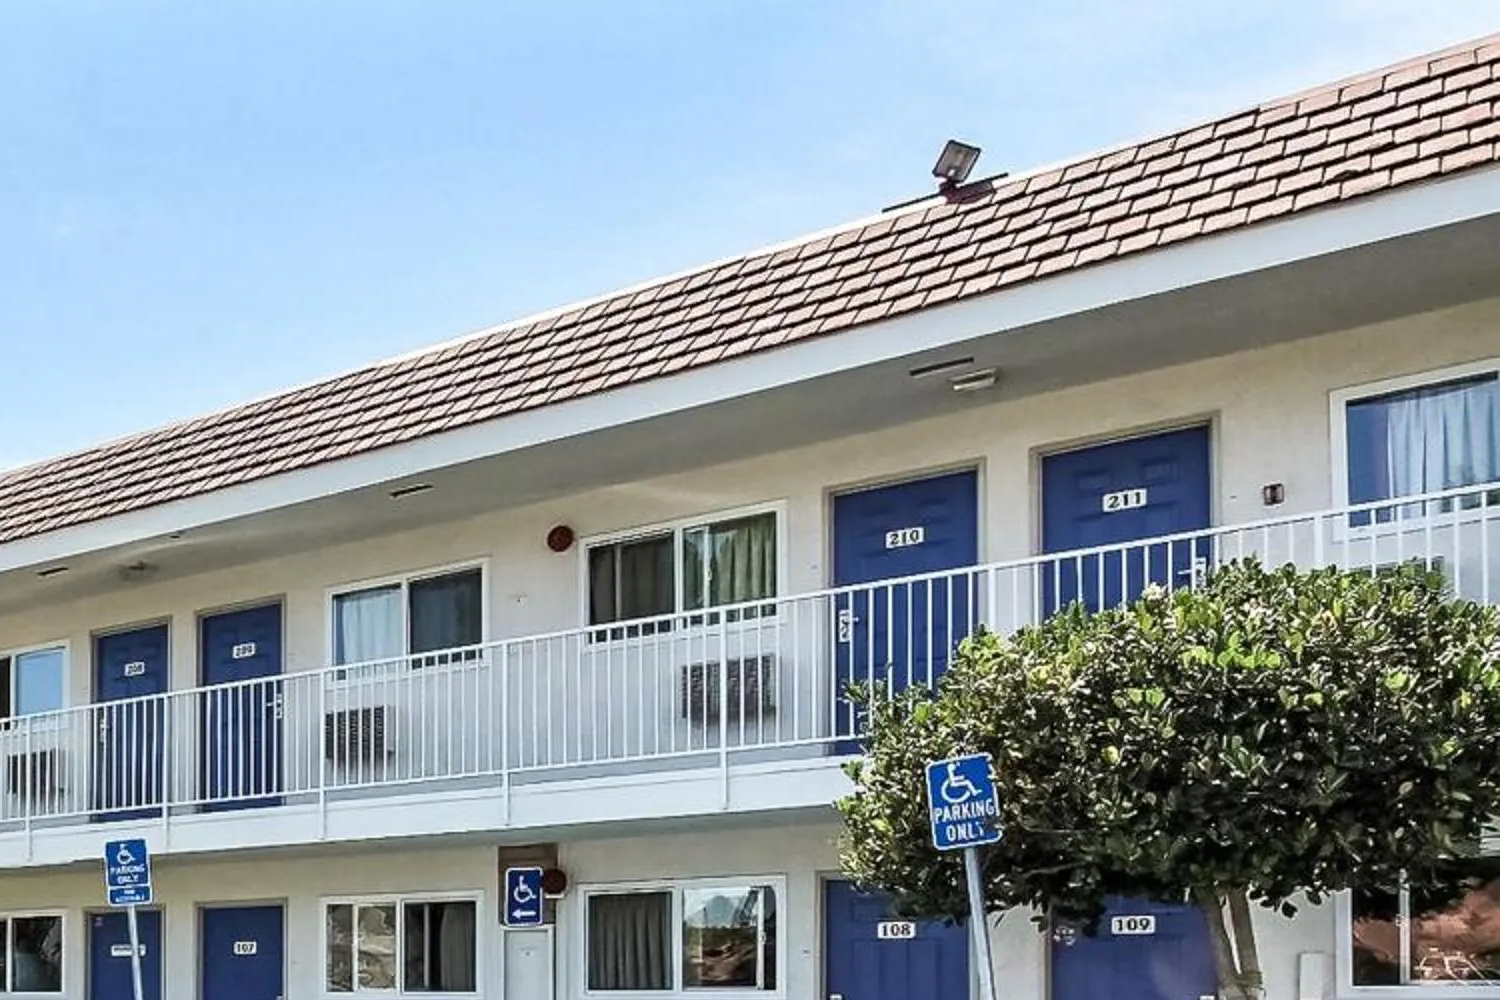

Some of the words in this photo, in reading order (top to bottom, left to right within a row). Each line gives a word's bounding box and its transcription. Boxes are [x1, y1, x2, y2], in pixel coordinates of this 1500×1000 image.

[1107, 491, 1142, 509] 211
[889, 529, 920, 546] 210
[934, 798, 995, 824] PARKING
[881, 923, 912, 937] 108
[1115, 917, 1150, 932] 109
[236, 942, 255, 953] 107
